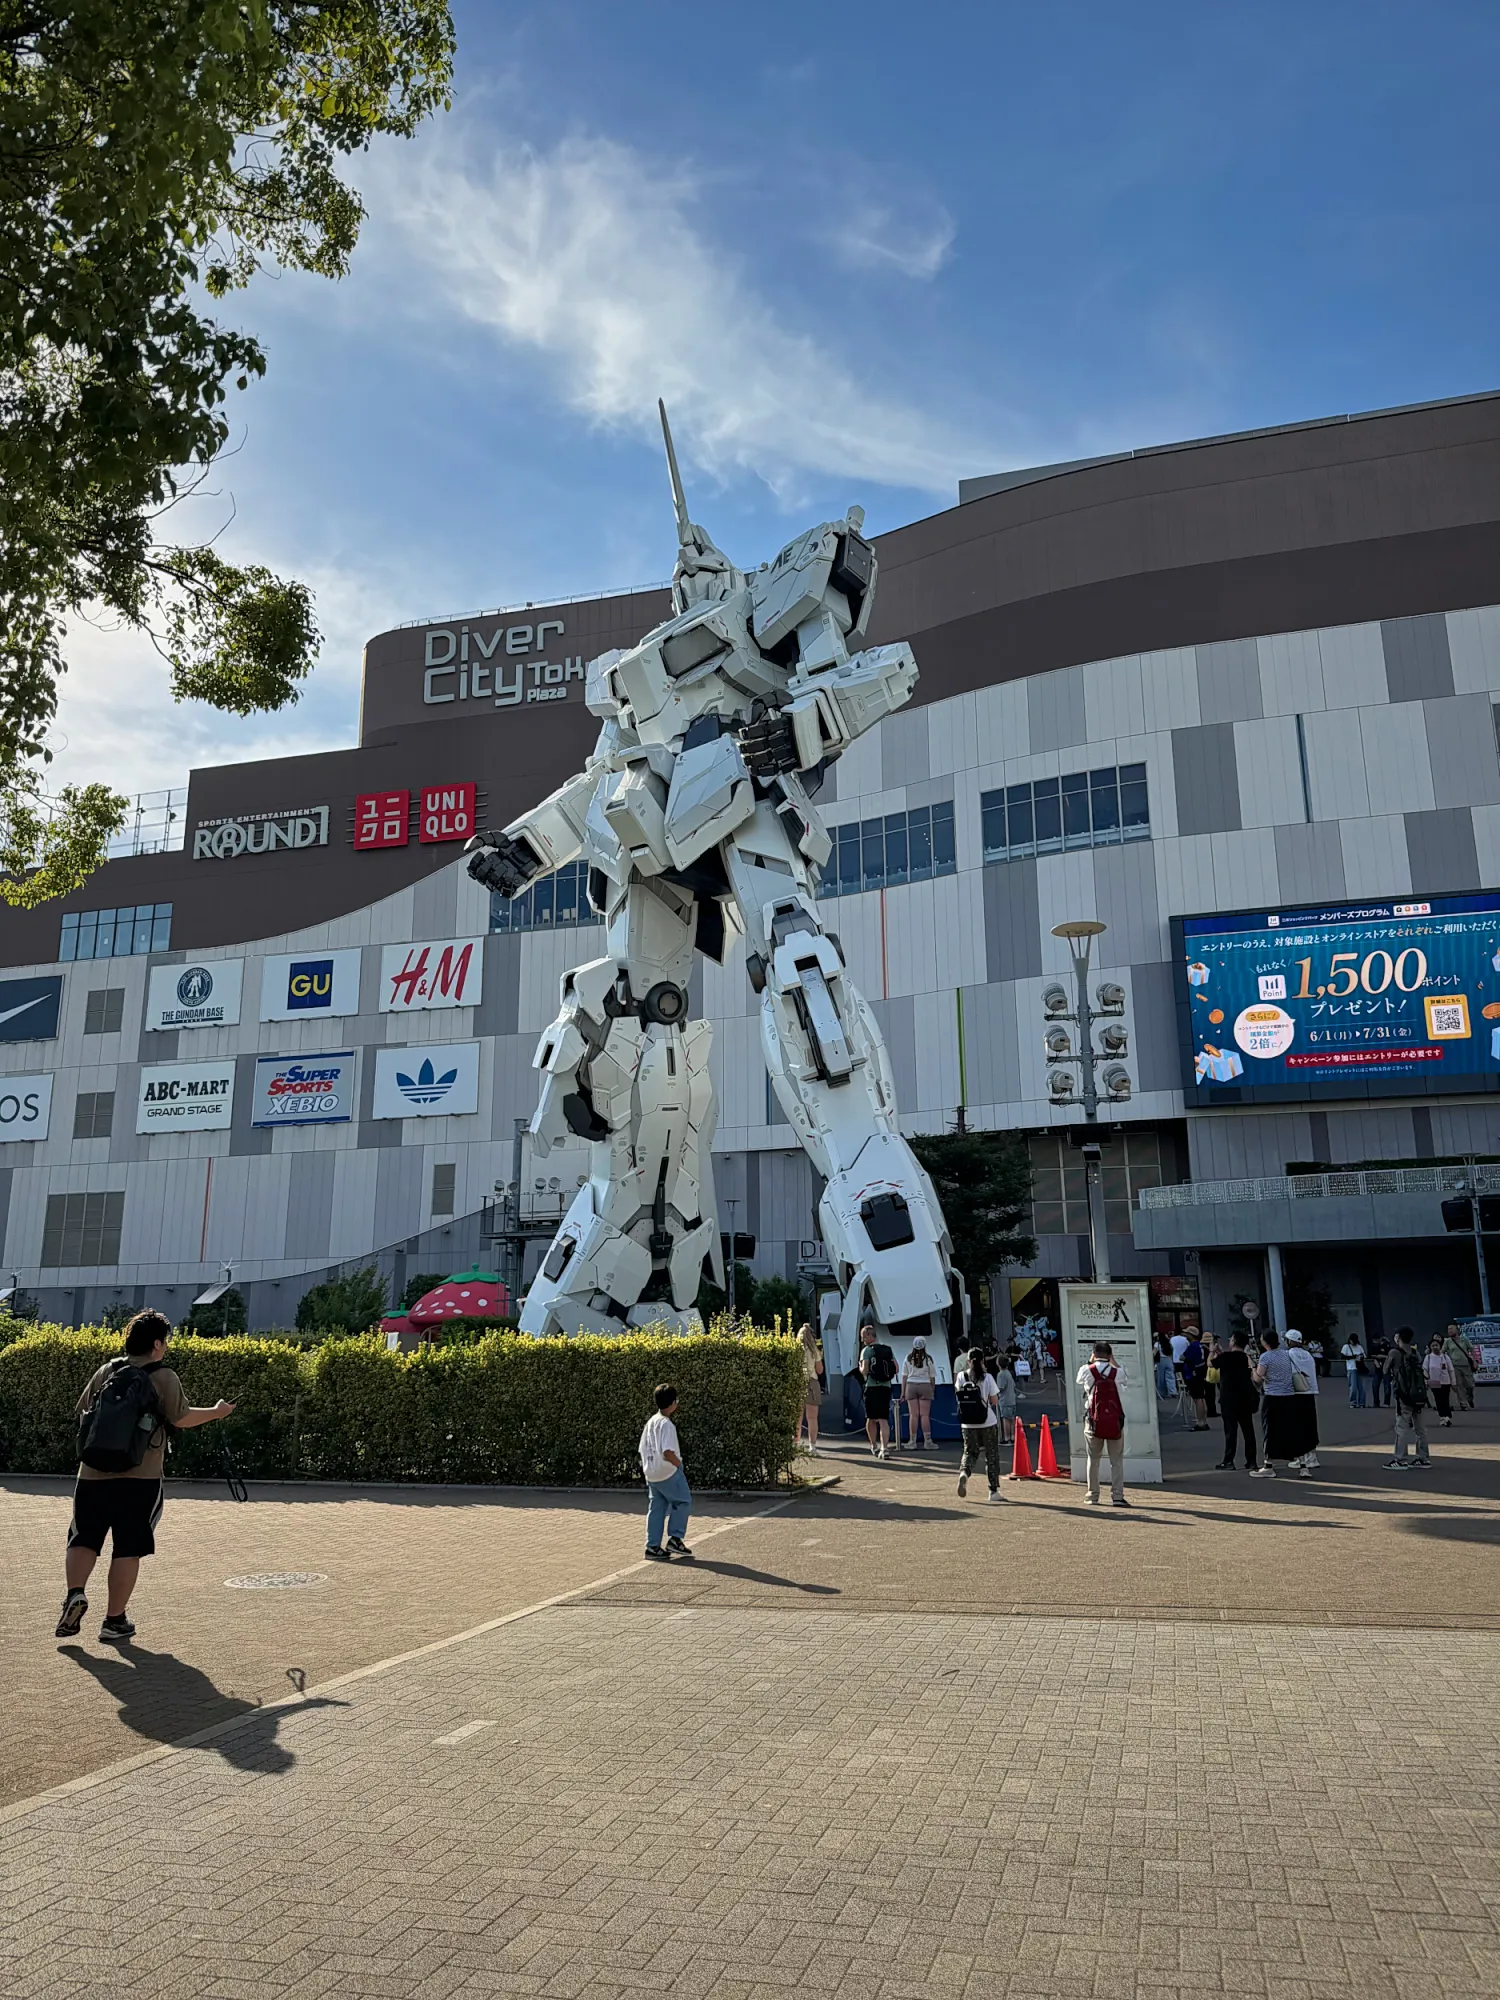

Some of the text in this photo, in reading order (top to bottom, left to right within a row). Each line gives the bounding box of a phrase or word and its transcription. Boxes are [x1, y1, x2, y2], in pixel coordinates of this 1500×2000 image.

[425, 620, 565, 667] Diver
[424, 662, 523, 707] City
[527, 686, 567, 702] Plaza
[426, 790, 464, 812] UNI
[198, 807, 317, 828] SPORTS ENTERTAINMENT
[426, 812, 467, 837] QLO
[1320, 907, 1390, 920] メンバーズプログラム
[390, 943, 474, 1006] H&M
[1256, 959, 1286, 973] もれなく
[1292, 948, 1460, 999] 1,500 ポイント
[291, 973, 331, 997] GU
[1263, 990, 1282, 998] Point
[162, 1006, 225, 1021] THE GUNDAM BASE
[1289, 1049, 1441, 1065] キャンペーン参加にはエントリーが必要です
[286, 1065, 341, 1082] SUPER
[144, 1079, 229, 1101] ABC-MART
[267, 1078, 334, 1096] SPORTS
[147, 1104, 222, 1117] GRAND STAGE
[266, 1093, 339, 1116] XEBIO
